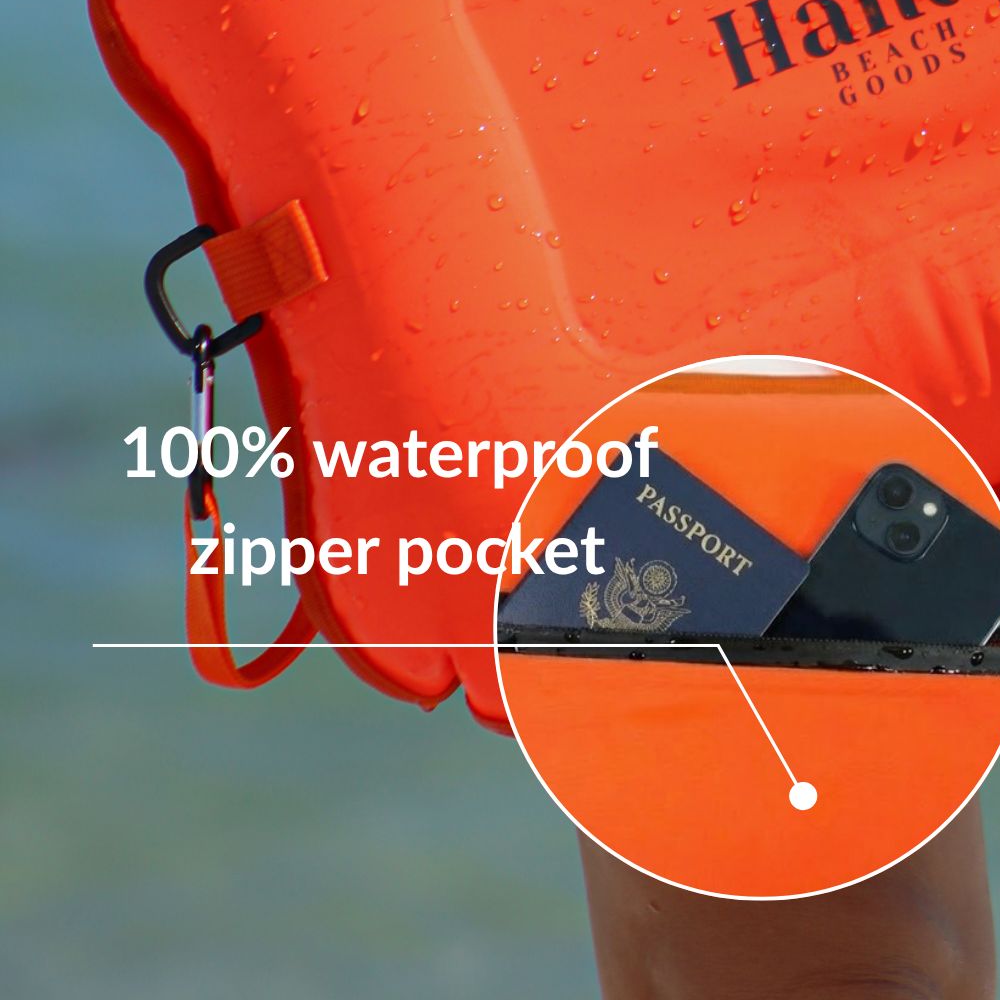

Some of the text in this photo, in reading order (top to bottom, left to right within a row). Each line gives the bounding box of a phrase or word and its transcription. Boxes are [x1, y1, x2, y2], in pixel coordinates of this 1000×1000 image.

[831, 18, 957, 83] BEACH
[838, 42, 966, 106] GOODS
[636, 483, 753, 577] PASSPORT
